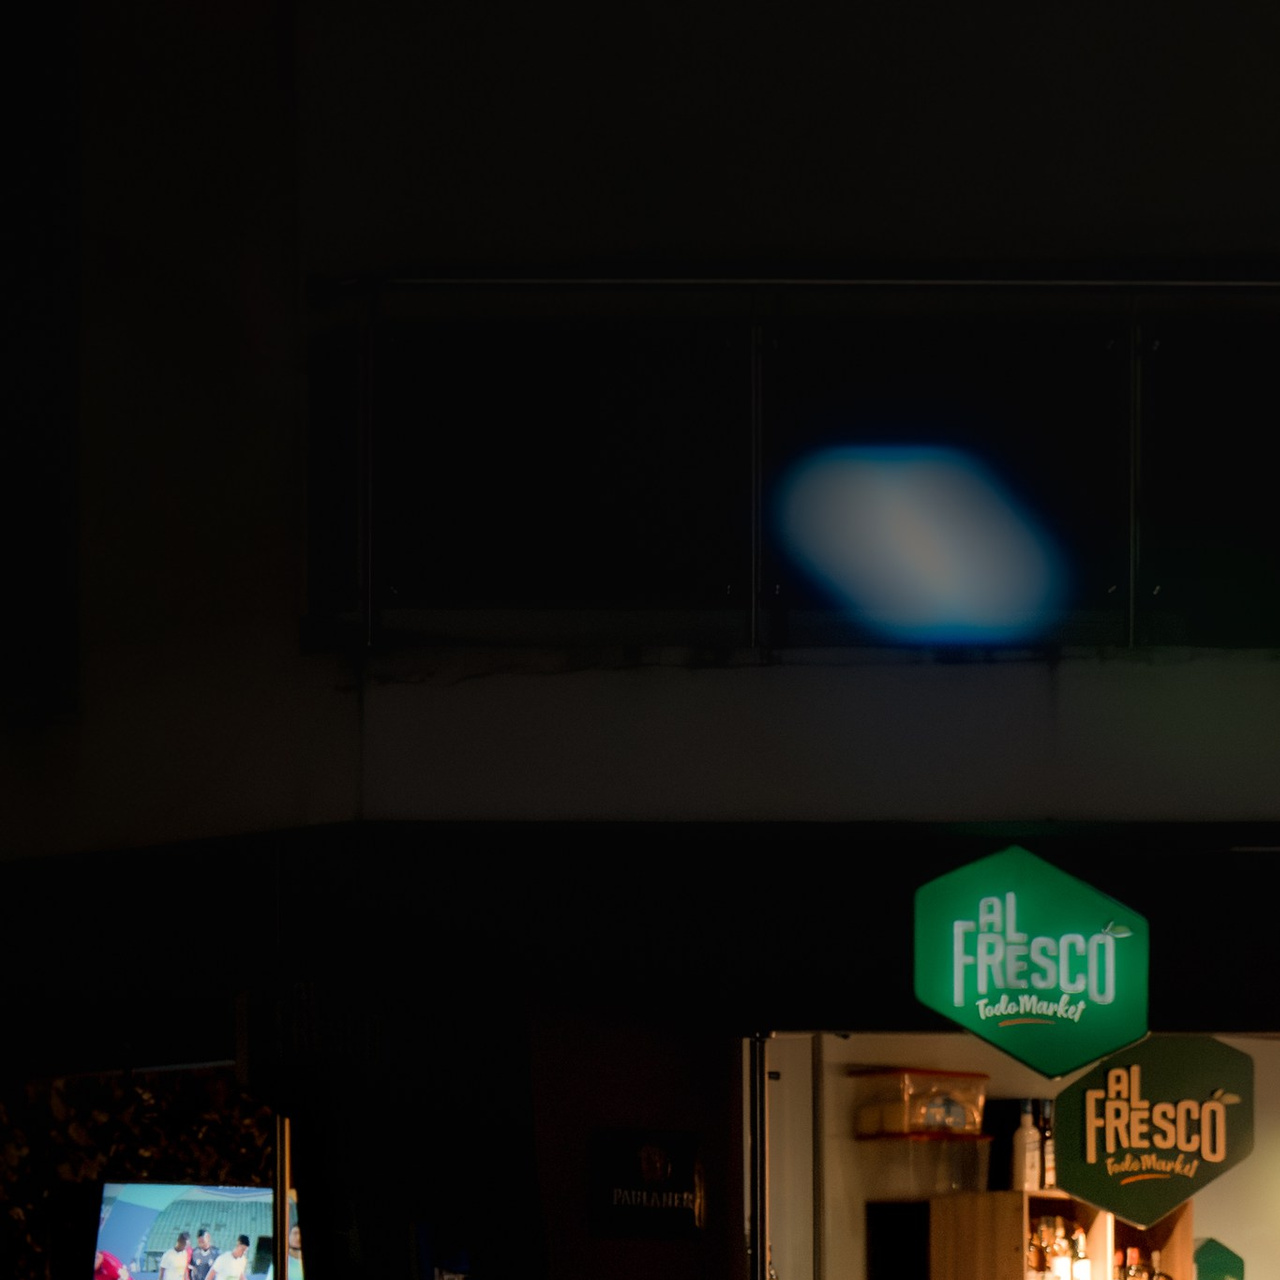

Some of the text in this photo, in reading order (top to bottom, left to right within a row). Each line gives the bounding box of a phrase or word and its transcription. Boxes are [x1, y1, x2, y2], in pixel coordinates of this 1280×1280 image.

[979, 892, 1027, 943] AL
[953, 921, 1116, 1007] FRESCO
[1107, 1064, 1150, 1109] AL
[1086, 1089, 1227, 1164] FRESCO
